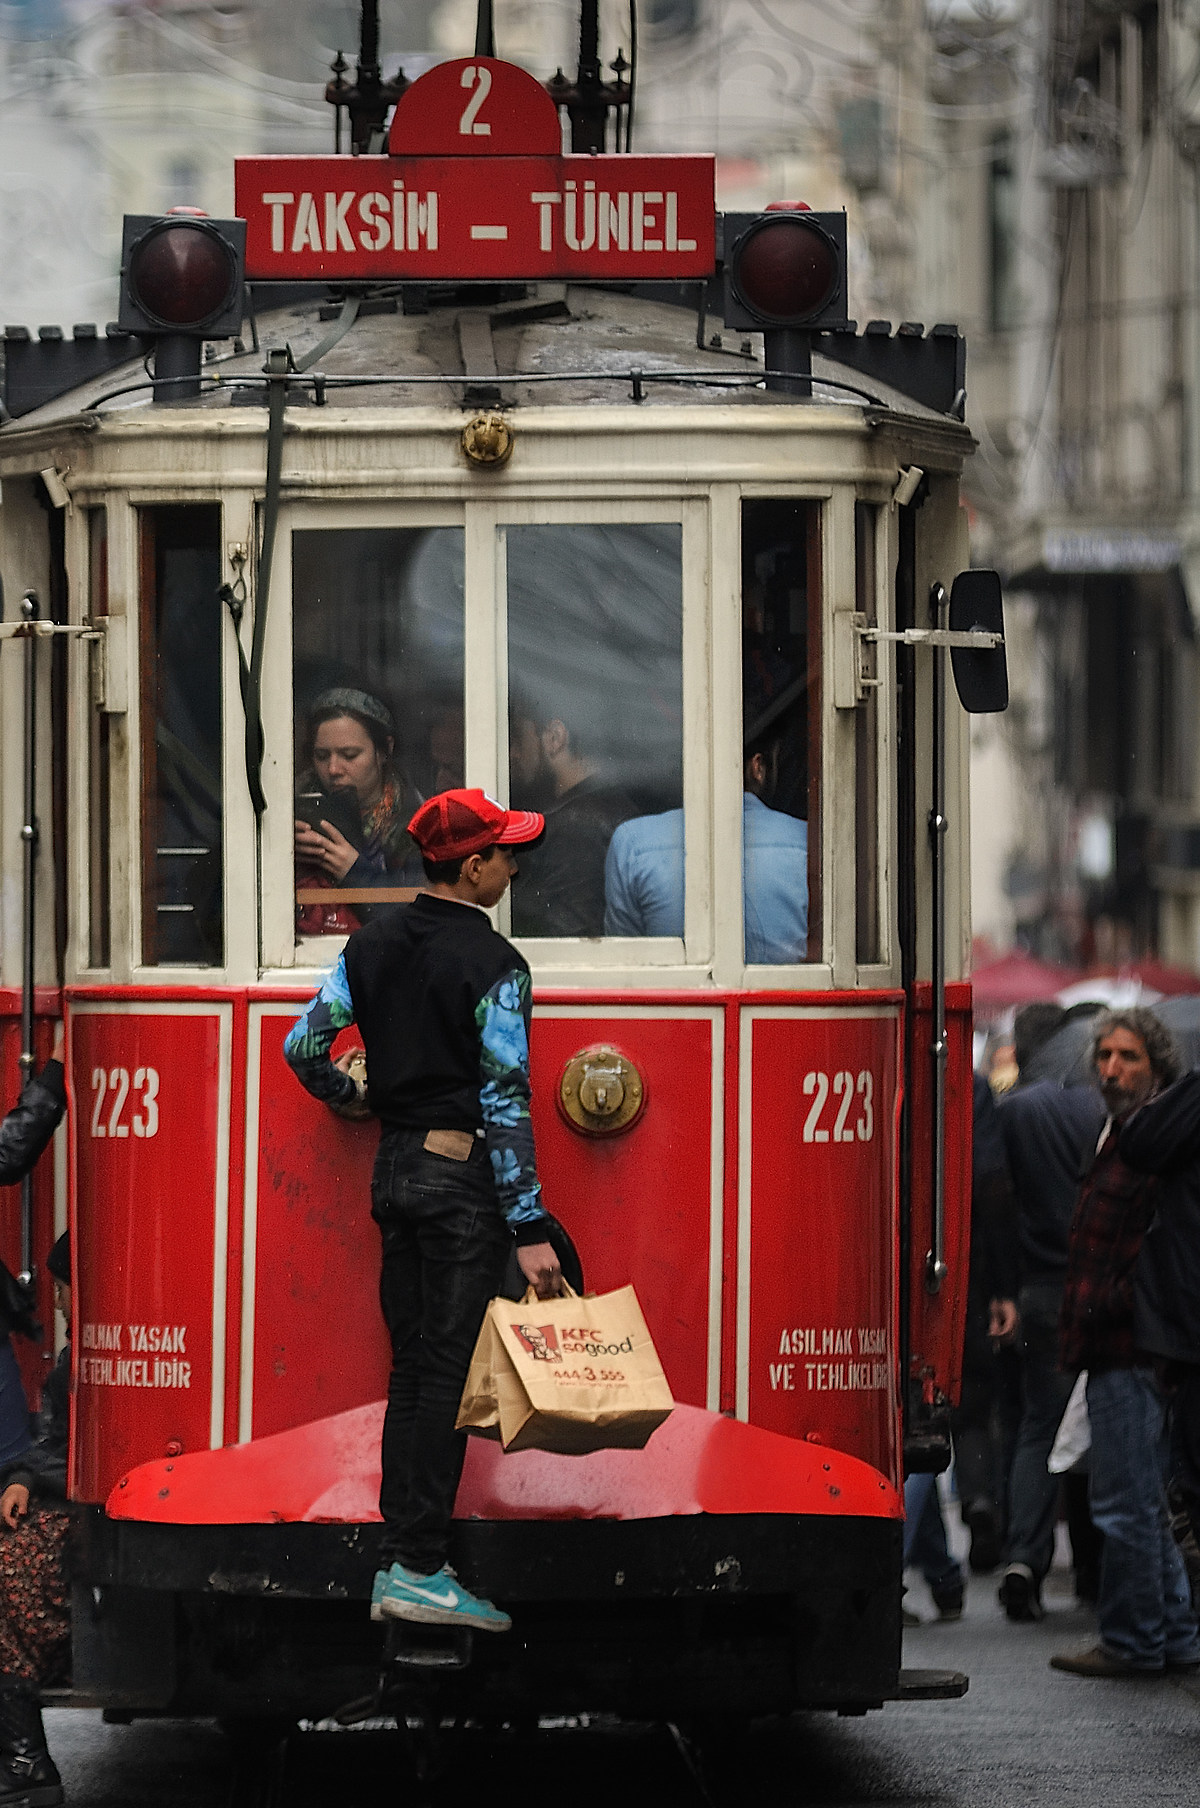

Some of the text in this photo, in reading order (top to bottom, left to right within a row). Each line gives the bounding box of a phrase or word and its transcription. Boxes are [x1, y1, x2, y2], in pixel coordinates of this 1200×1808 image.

[459, 65, 493, 136] 2
[262, 179, 439, 253] TAKSİM
[531, 180, 697, 252] TÜNEL
[91, 1067, 160, 1138] 223
[803, 1070, 874, 1142] 223
[129, 1325, 187, 1353] YASAK
[561, 1328, 603, 1343] KFC
[778, 1328, 853, 1355] ASILMAK
[584, 1366, 596, 1381] 3
[600, 1369, 625, 1381] 555
[768, 1363, 796, 1390] VE
